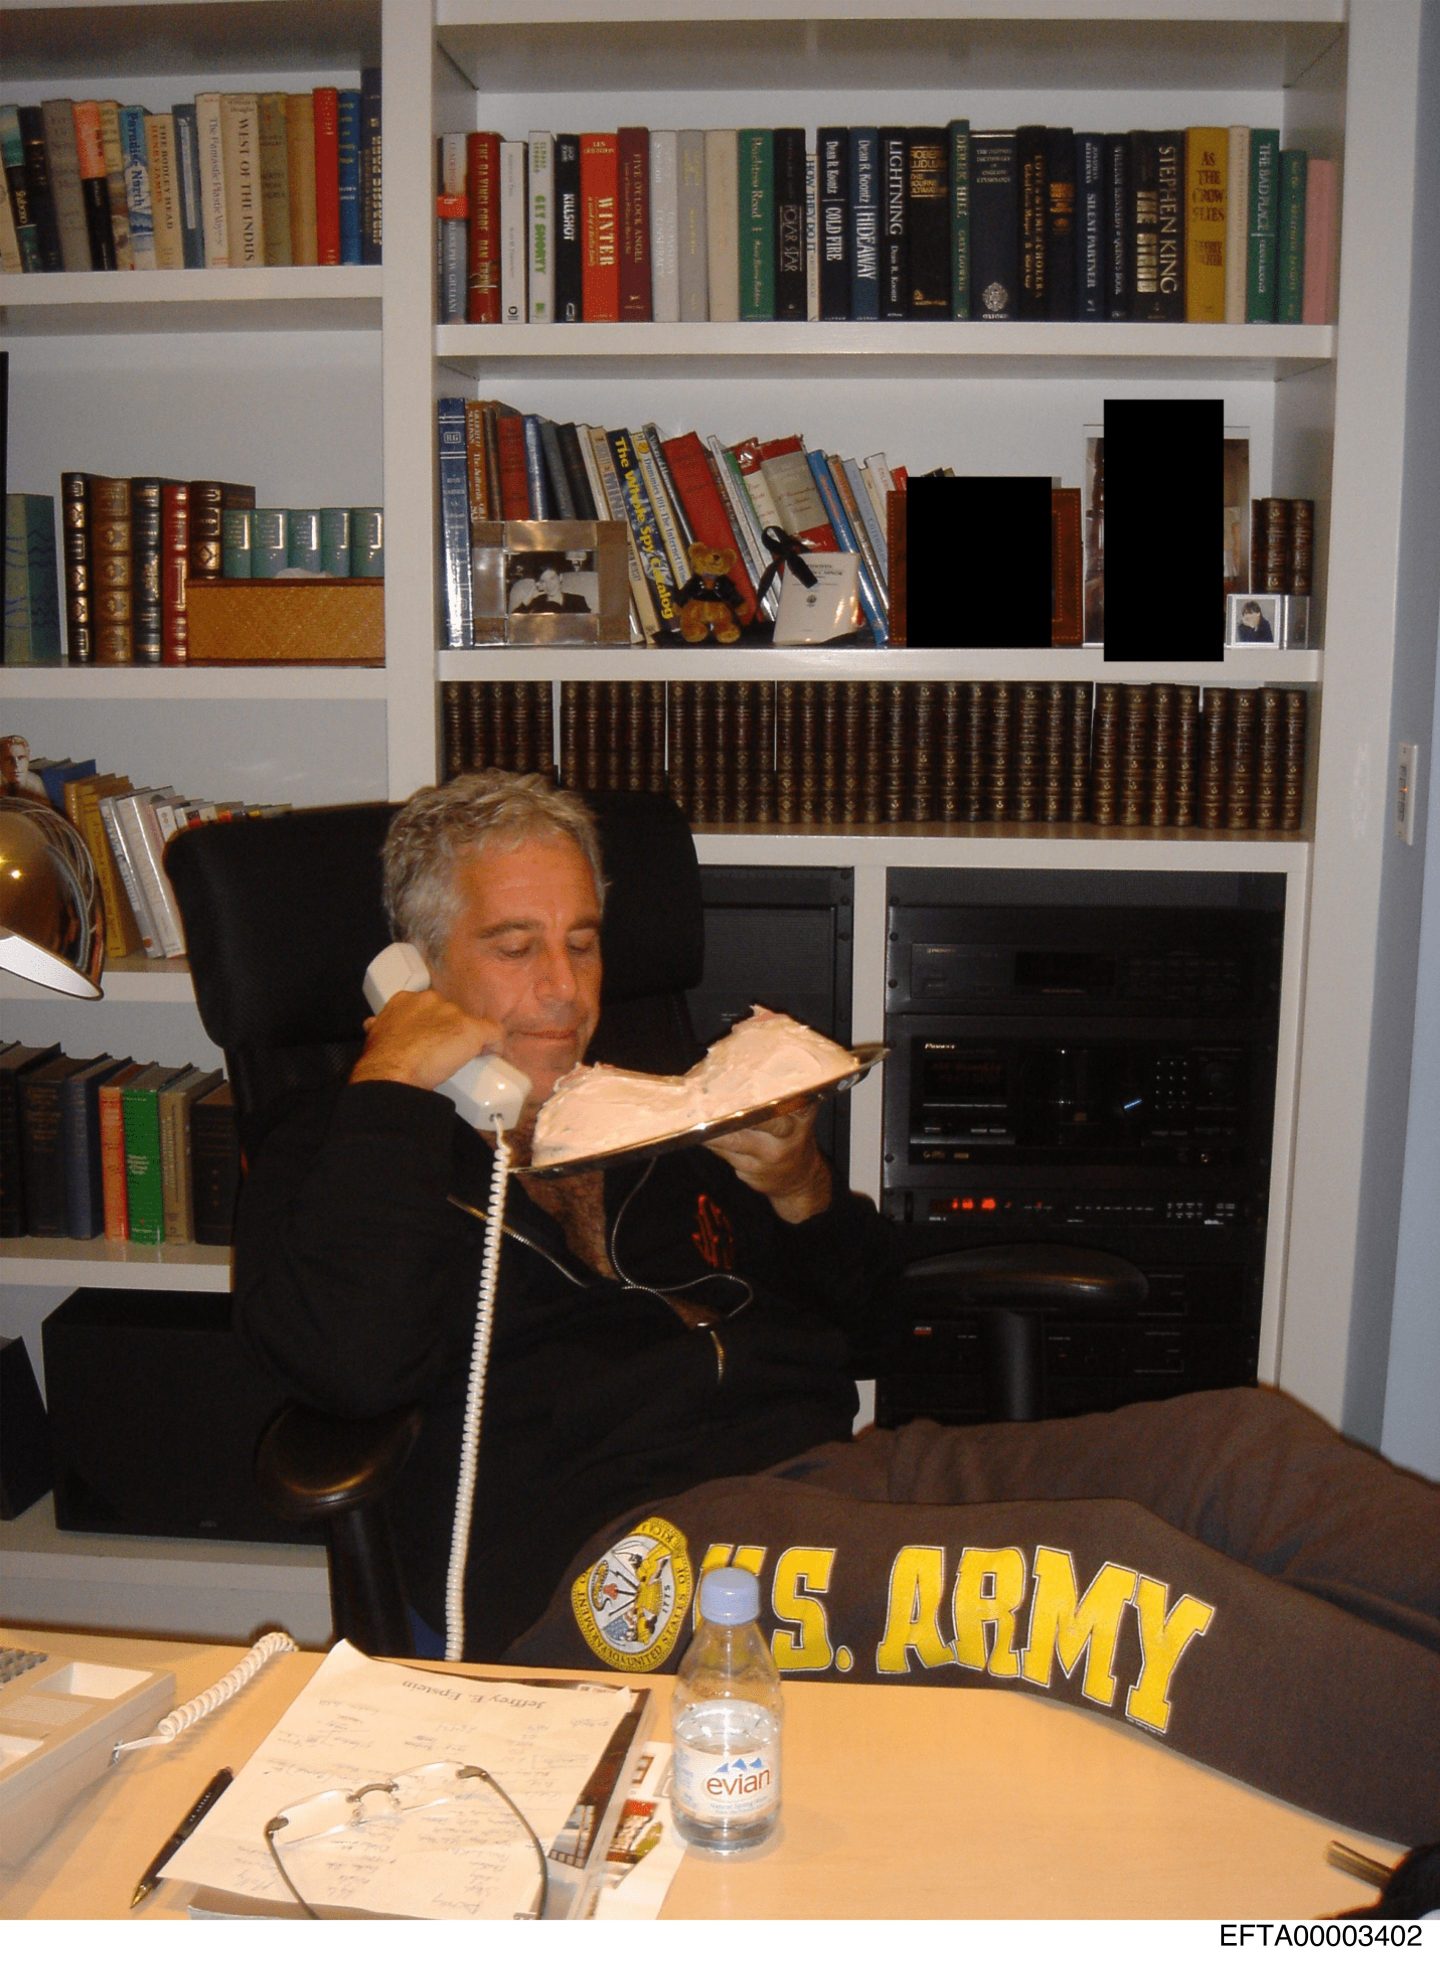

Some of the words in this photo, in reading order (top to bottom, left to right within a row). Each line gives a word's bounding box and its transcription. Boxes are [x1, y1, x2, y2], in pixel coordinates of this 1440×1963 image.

[160, 125, 168, 147] THE
[209, 118, 218, 134] The
[238, 118, 250, 155] WEST
[151, 125, 160, 163] HENRY
[210, 135, 221, 179] Fantastic
[372, 136, 381, 173] PARK
[478, 143, 488, 160] THE
[825, 141, 838, 160] Dean
[858, 140, 871, 162] Dean
[1258, 143, 1271, 168] THE
[161, 150, 170, 192] BODLEY
[240, 160, 251, 179] OF
[478, 164, 488, 177] DA
[633, 153, 642, 177] FIVE
[826, 161, 838, 169] R.
[859, 164, 871, 172] R.
[1201, 152, 1216, 166] AS
[153, 167, 162, 203] JAMES
[806, 160, 816, 188] HOW
[826, 170, 838, 194] Koontz
[889, 141, 903, 235] LIGHTNING
[1197, 170, 1221, 185] THE
[1258, 169, 1270, 193] BAD
[131, 170, 143, 207] North
[213, 182, 224, 214] Plastic
[241, 184, 253, 211] THE
[478, 178, 488, 205] VINCI
[858, 174, 872, 203] Koontz
[957, 186, 968, 218] HILL
[1158, 146, 1177, 233] STEPHEN
[164, 197, 173, 230] HEAD
[372, 178, 382, 245] JURASSIC
[534, 195, 545, 219] GET
[634, 181, 643, 225] O'CLOCK
[751, 191, 763, 218] Road
[806, 192, 816, 220] THEY
[1086, 193, 1096, 232] SILENT
[1257, 194, 1270, 231] PLACE
[563, 194, 575, 242] KILLSHOT
[599, 196, 614, 266] WINTER
[783, 205, 799, 241] POLAR
[806, 223, 816, 238] DO
[825, 207, 842, 233] COLD
[242, 216, 255, 261] INDUS
[478, 239, 488, 258] DAN
[534, 224, 546, 274] SHORTY
[634, 229, 643, 264] ANGEL
[806, 242, 816, 252] IT
[826, 236, 843, 261] FIRE
[856, 212, 876, 280] HIDEAWAY
[784, 247, 798, 272] STAR
[890, 245, 899, 264] Dean
[1086, 235, 1097, 288] PARTNER
[1159, 240, 1178, 294] KING
[890, 266, 898, 274] R.
[1035, 244, 1043, 298] CHOLERA
[448, 274, 457, 313] GIULIANI
[890, 276, 899, 302] Koontz
[473, 453, 482, 467] The
[644, 458, 662, 496] Dummies
[603, 472, 624, 520] MIND
[614, 436, 630, 468] The
[624, 470, 646, 523] Whole
[638, 526, 656, 553] Spy
[650, 557, 676, 620] Catalog
[659, 512, 672, 528] The
[662, 528, 681, 561] Internet
[662, 1584, 671, 1613] 1775
[627, 1647, 662, 1666] UNITED
[661, 1594, 686, 1645] STATES
[876, 1543, 1216, 1735] ARMY
[402, 1680, 462, 1701] Epstein
[468, 1694, 484, 1704] E.
[488, 1694, 547, 1710] Jeffrey
[706, 1768, 770, 1796] evian
